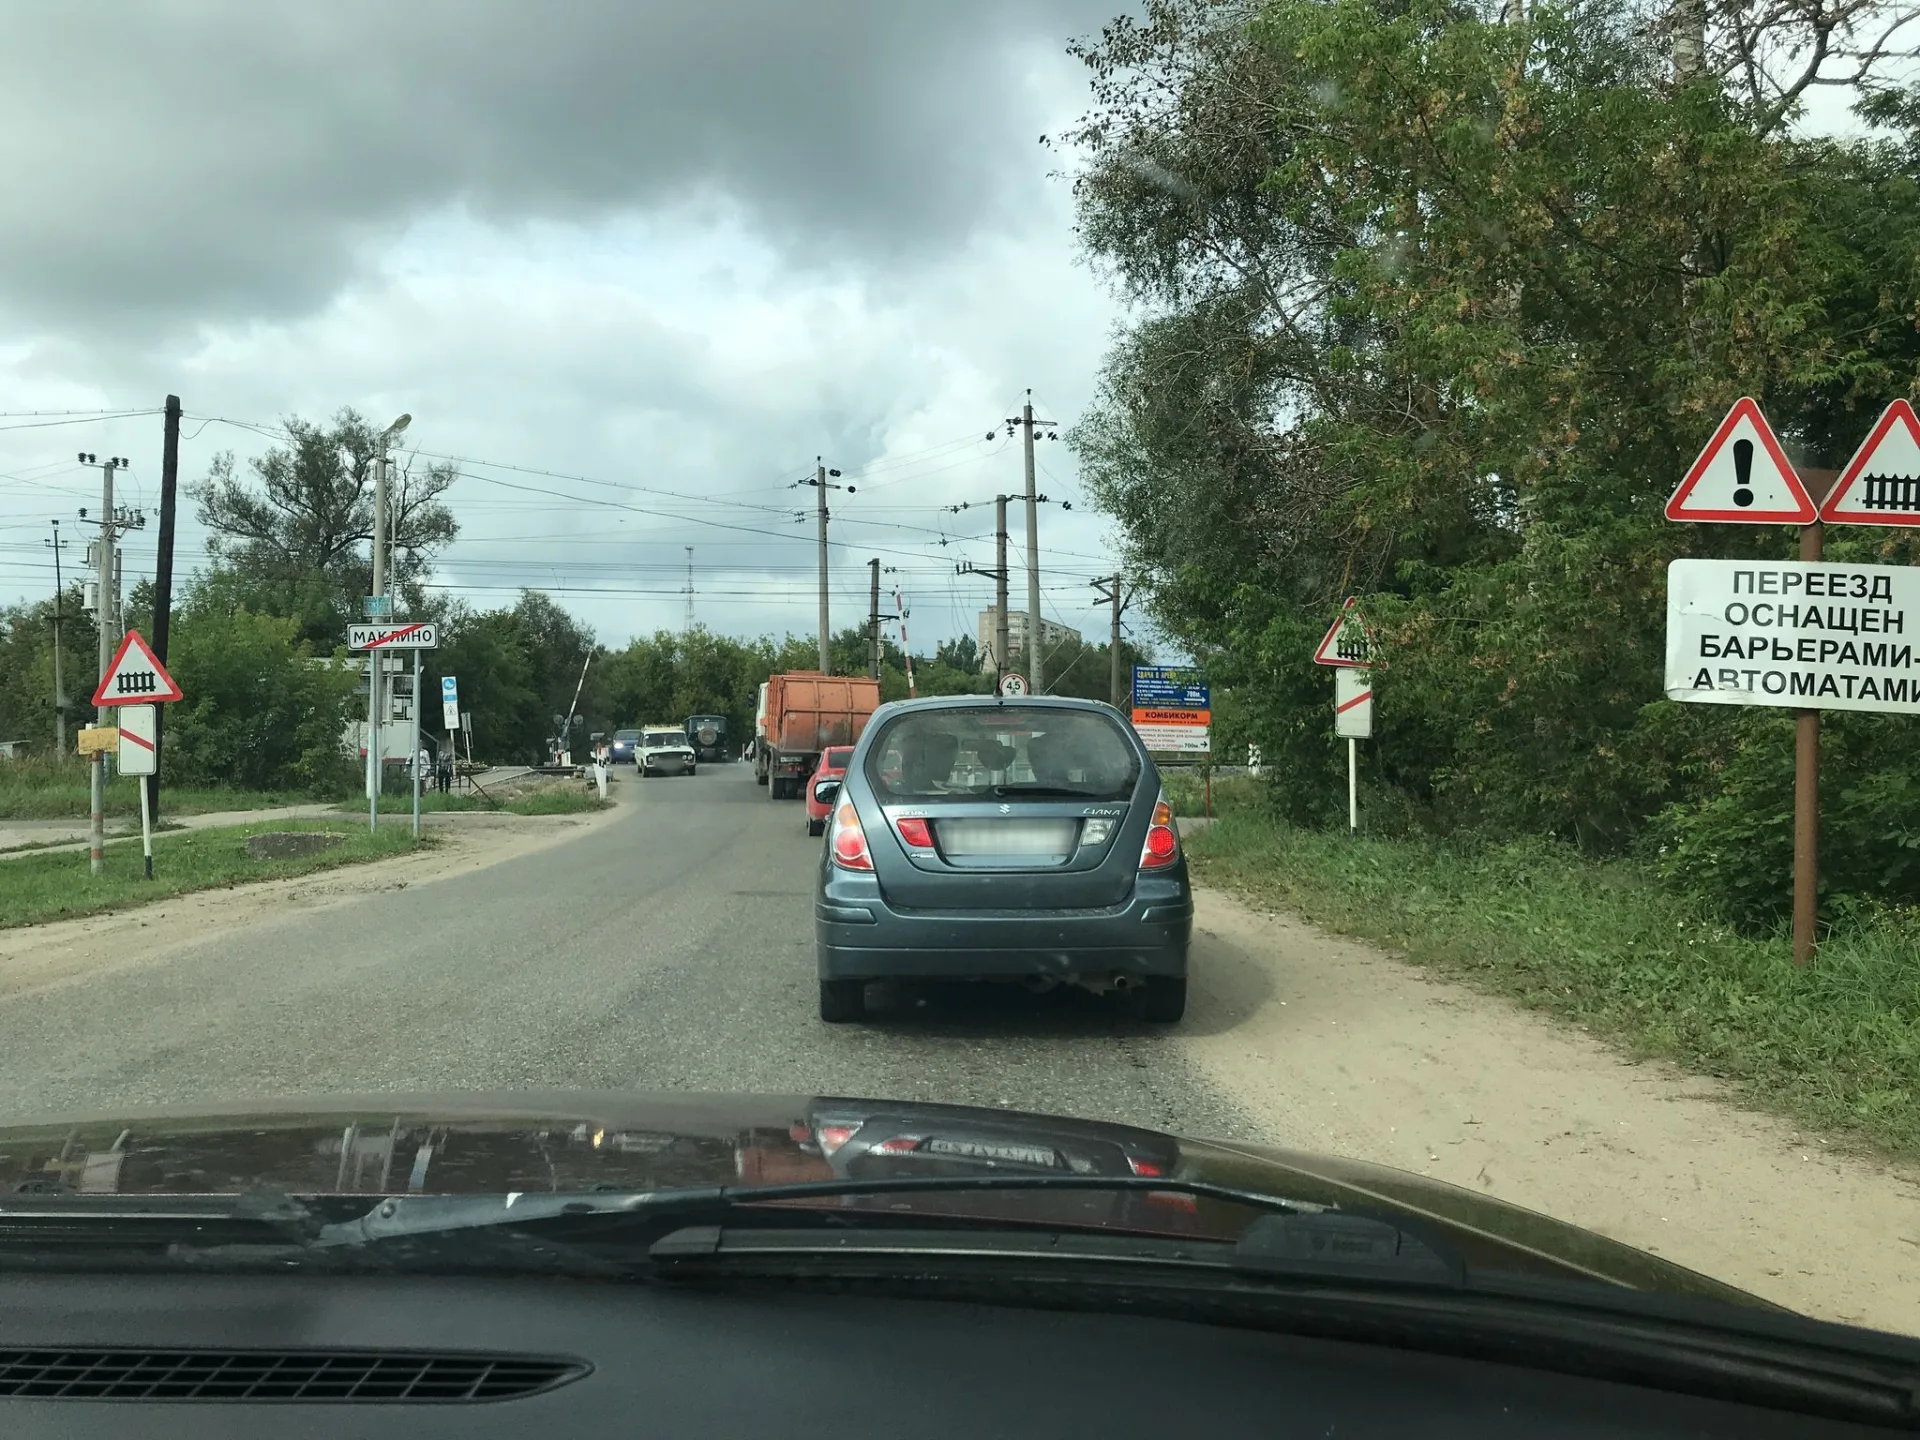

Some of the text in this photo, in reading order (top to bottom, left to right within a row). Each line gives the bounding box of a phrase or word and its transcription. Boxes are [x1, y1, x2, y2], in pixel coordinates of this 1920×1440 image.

[1733, 570, 1893, 604] ПЕРЕЕЗД
[1724, 602, 1904, 636] ОСНАЩЕН
[353, 630, 432, 644] МАКЛИНО
[1082, 807, 1121, 816] LIANA
